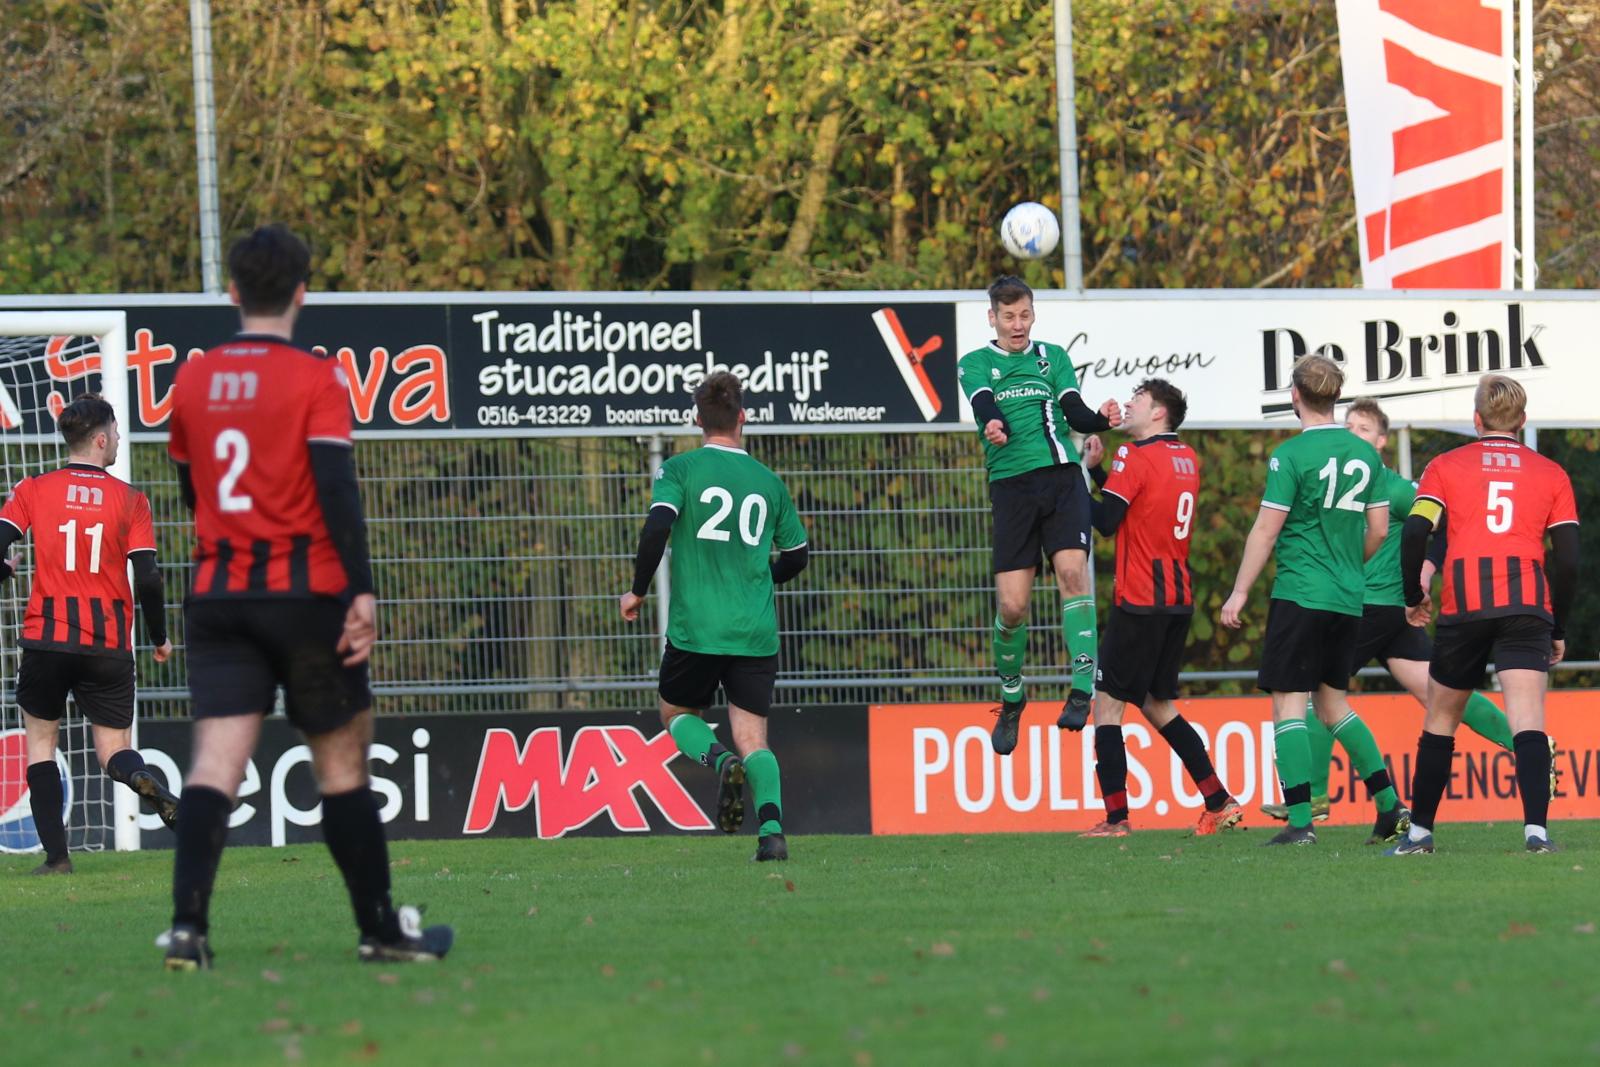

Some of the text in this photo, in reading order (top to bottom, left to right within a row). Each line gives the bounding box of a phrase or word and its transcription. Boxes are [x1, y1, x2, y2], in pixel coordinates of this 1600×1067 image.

[472, 308, 702, 353] Traditioneel
[1361, 302, 1550, 384] Brink
[477, 401, 886, 429] 0516-423229 boonstra.ge.nl Waskemeer
[994, 387, 1053, 402] ONKMAN
[215, 429, 253, 513] 2
[1318, 457, 1371, 513] 12
[696, 485, 768, 547] 20
[1173, 491, 1194, 540] 9
[1486, 481, 1514, 534] 5
[58, 519, 104, 574] 11
[462, 722, 720, 839] MAX
